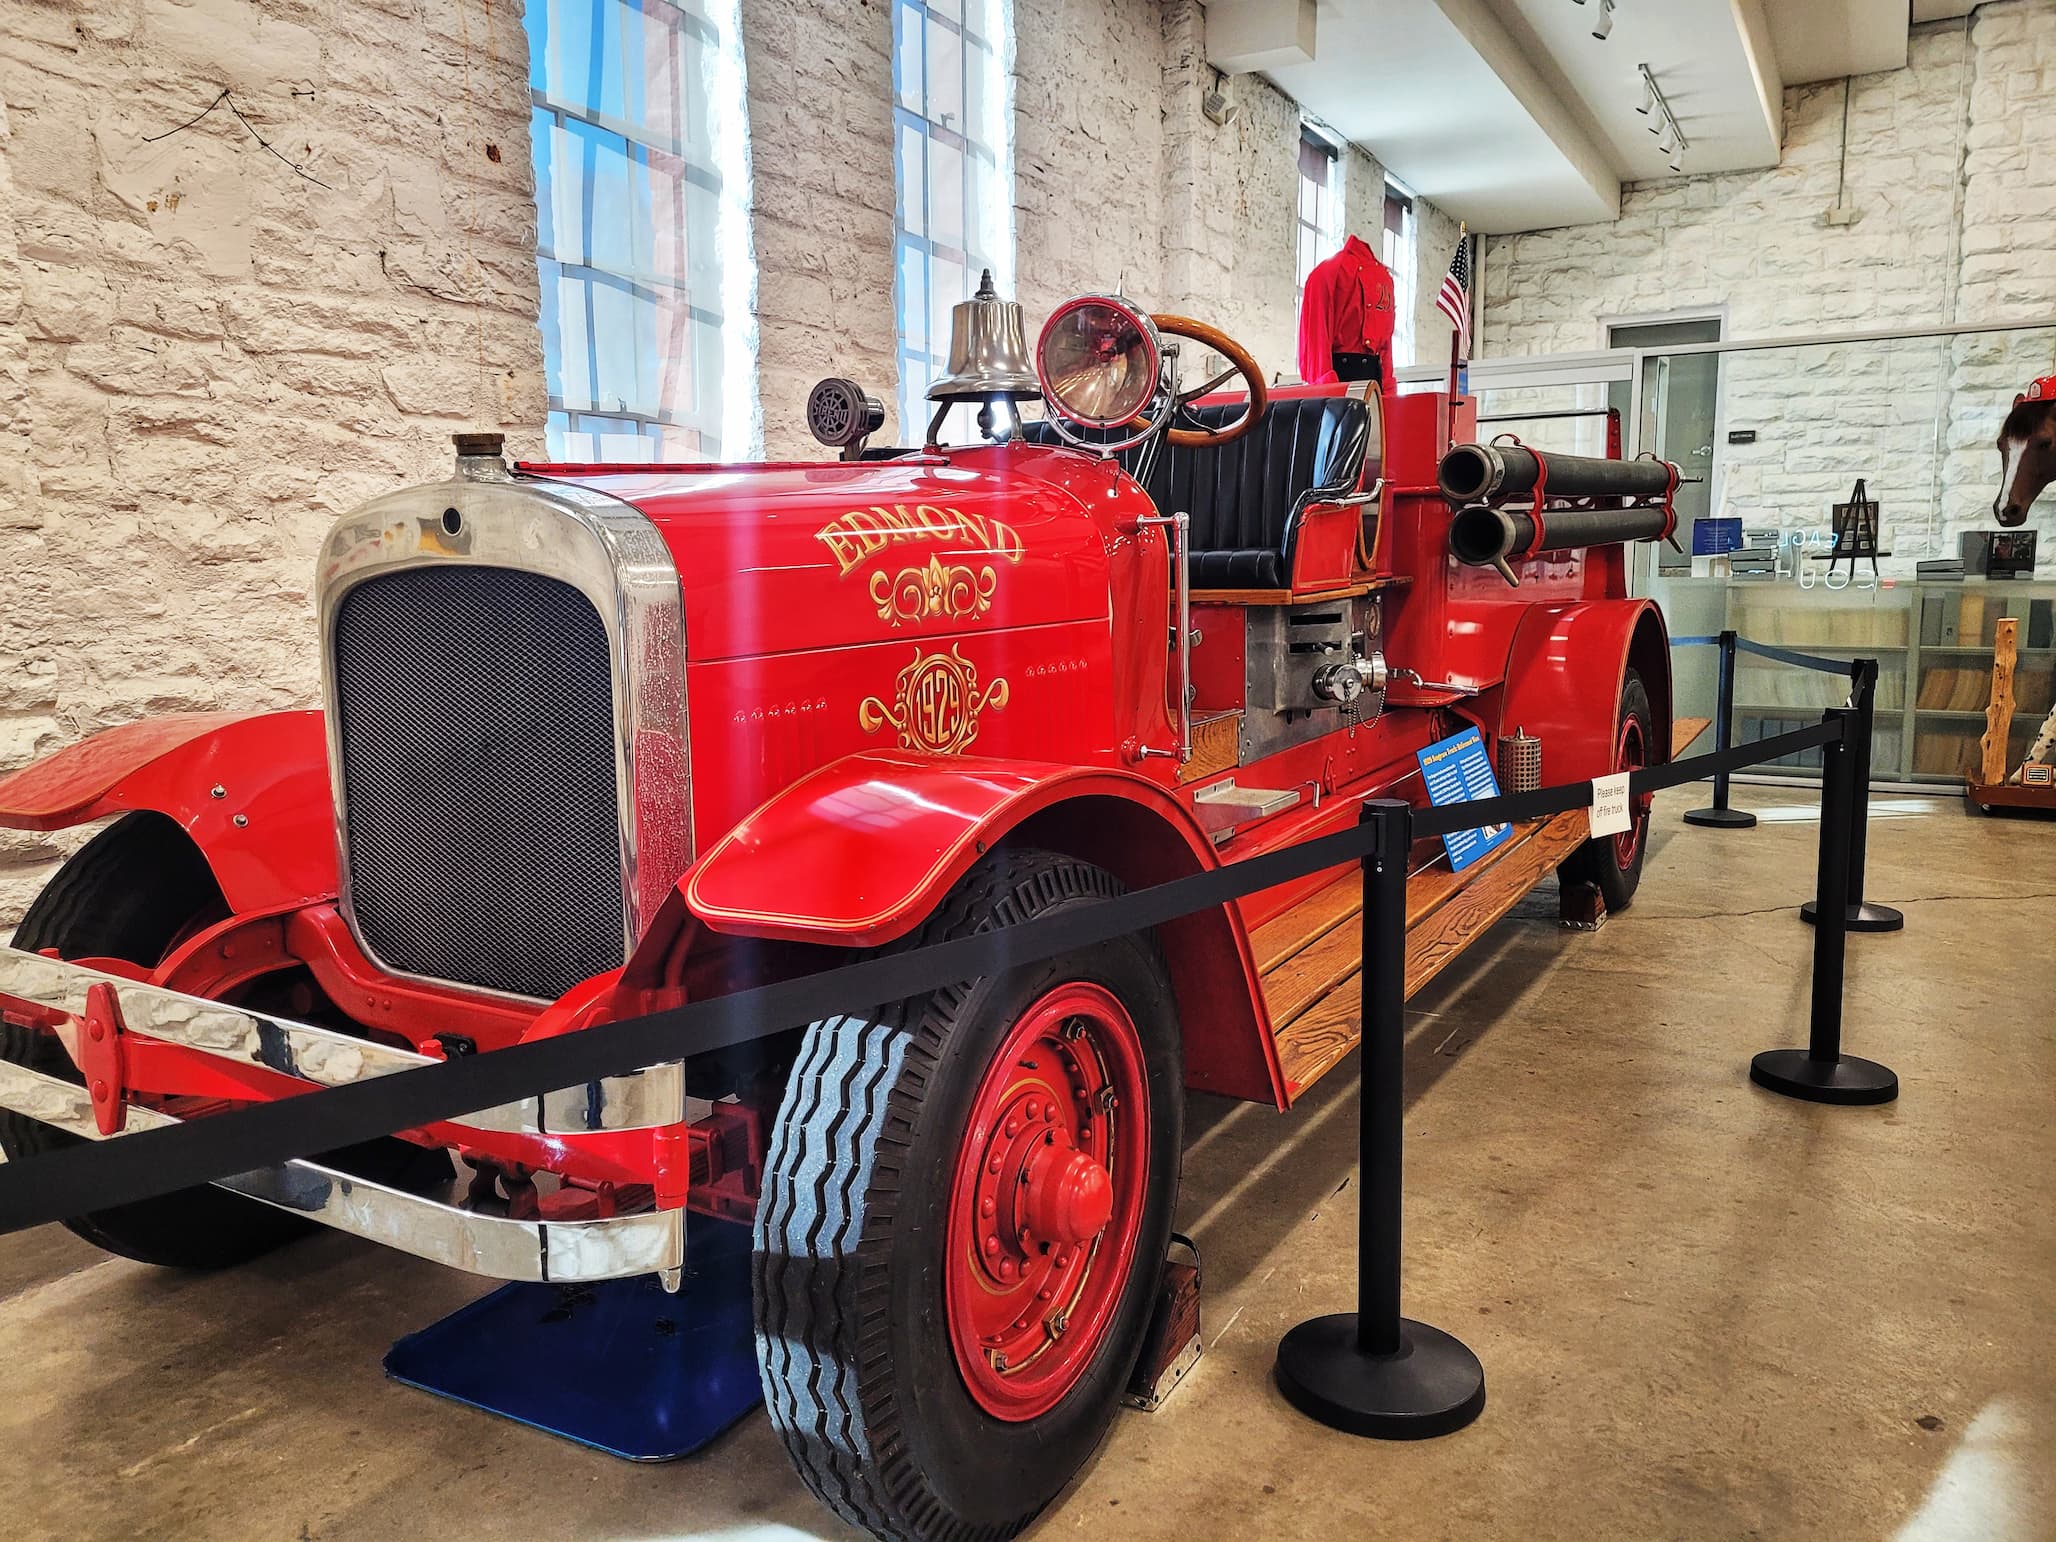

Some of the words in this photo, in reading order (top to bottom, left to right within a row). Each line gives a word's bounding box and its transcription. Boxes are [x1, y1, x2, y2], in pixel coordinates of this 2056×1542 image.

[814, 504, 1024, 577] EDMOND
[915, 669, 961, 745] 1929
[1597, 787, 1613, 799] Please
[1614, 784, 1625, 797] keep
[1603, 805, 1611, 816] fire
[1611, 802, 1624, 815] truck
